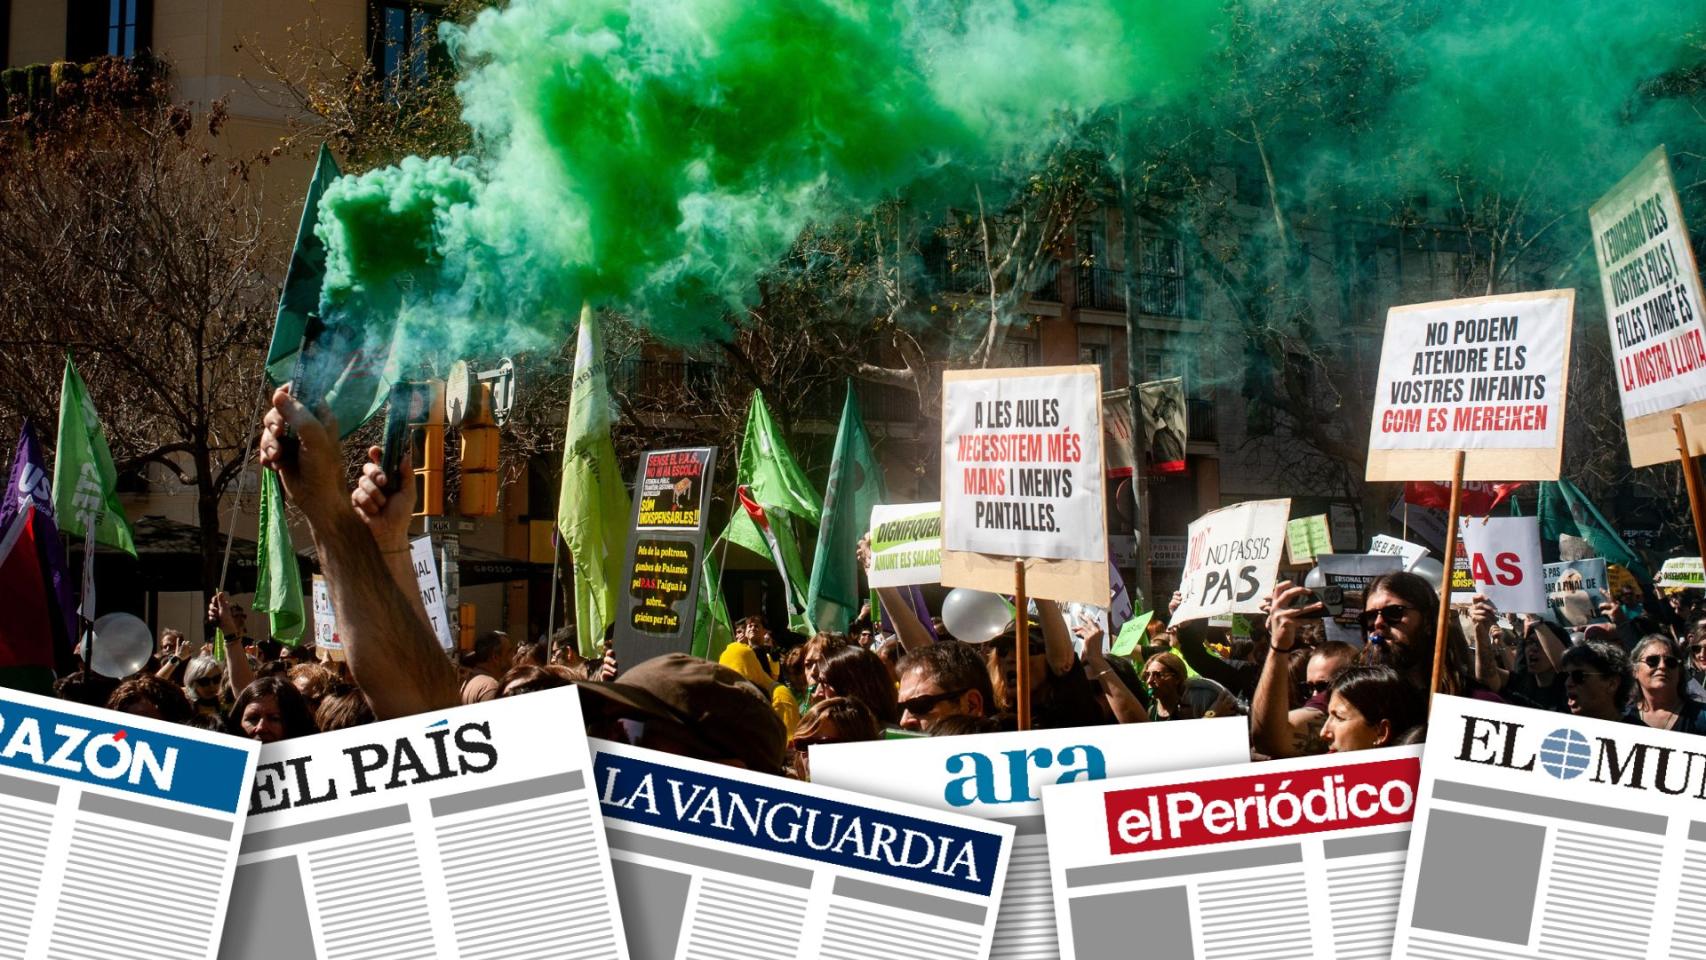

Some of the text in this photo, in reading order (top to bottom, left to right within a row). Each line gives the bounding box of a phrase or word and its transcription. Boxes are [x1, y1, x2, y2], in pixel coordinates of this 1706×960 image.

[1641, 193, 1668, 240] DELS
[1610, 257, 1649, 307] VOSTRES
[1644, 243, 1672, 289] FILLS
[1615, 279, 1693, 350] FILLES TAMBÉ ÉS
[1425, 316, 1518, 346] NO PODEM
[1412, 346, 1527, 376] ATENDRE ELS
[1620, 329, 1706, 392] LA NOSTRA LLUITA
[1391, 375, 1546, 405] VOSTRES INFANTS
[974, 398, 1059, 429] A LES AULES
[1382, 405, 1548, 433] COM ES MEREIXEN
[957, 426, 1081, 463] NECESSITEM MÉS
[963, 468, 1072, 498] MANS I MENYS
[975, 501, 1061, 533] PANTALLES.
[1206, 544, 1228, 566] NO
[1229, 537, 1270, 563] PASSIS
[1200, 565, 1260, 606] PAS
